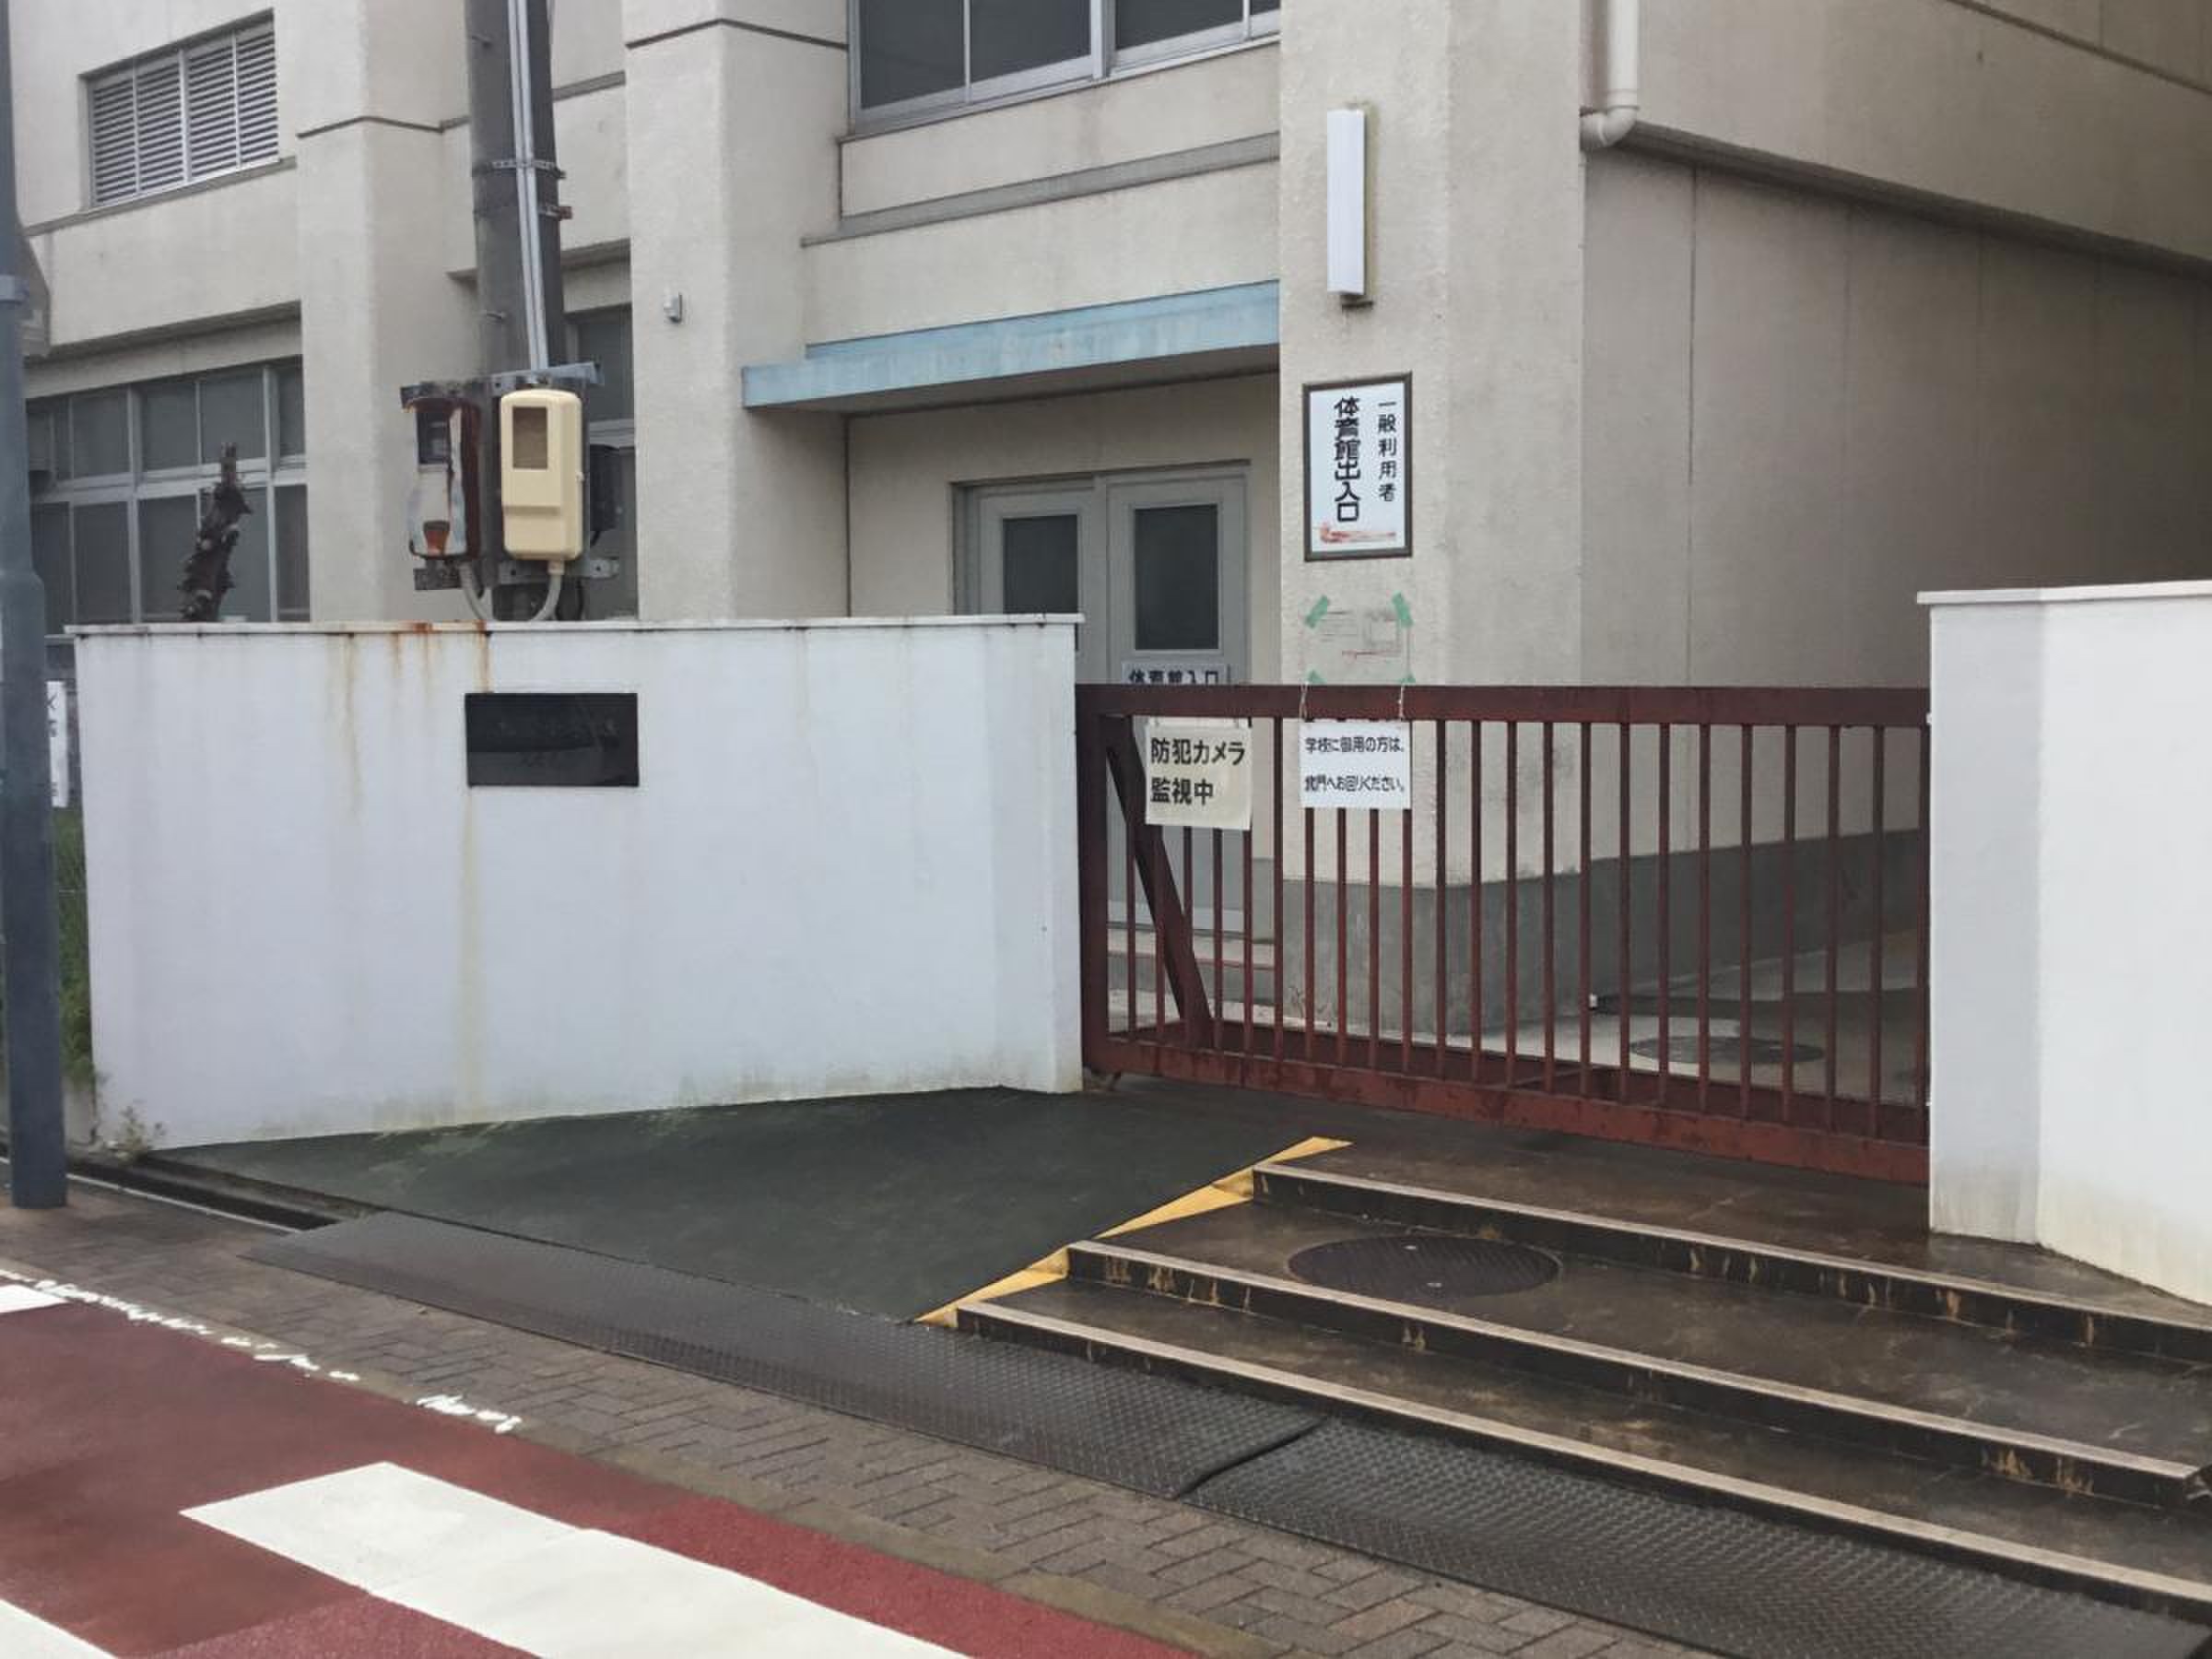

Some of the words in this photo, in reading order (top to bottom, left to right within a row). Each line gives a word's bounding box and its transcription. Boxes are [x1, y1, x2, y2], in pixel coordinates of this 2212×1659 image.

[1334, 395, 1361, 524] 体育館出入口
[1378, 401, 1397, 502] 一般利用者
[1151, 737, 1245, 766] 防犯カメラ
[1150, 778, 1214, 806] 監視中
